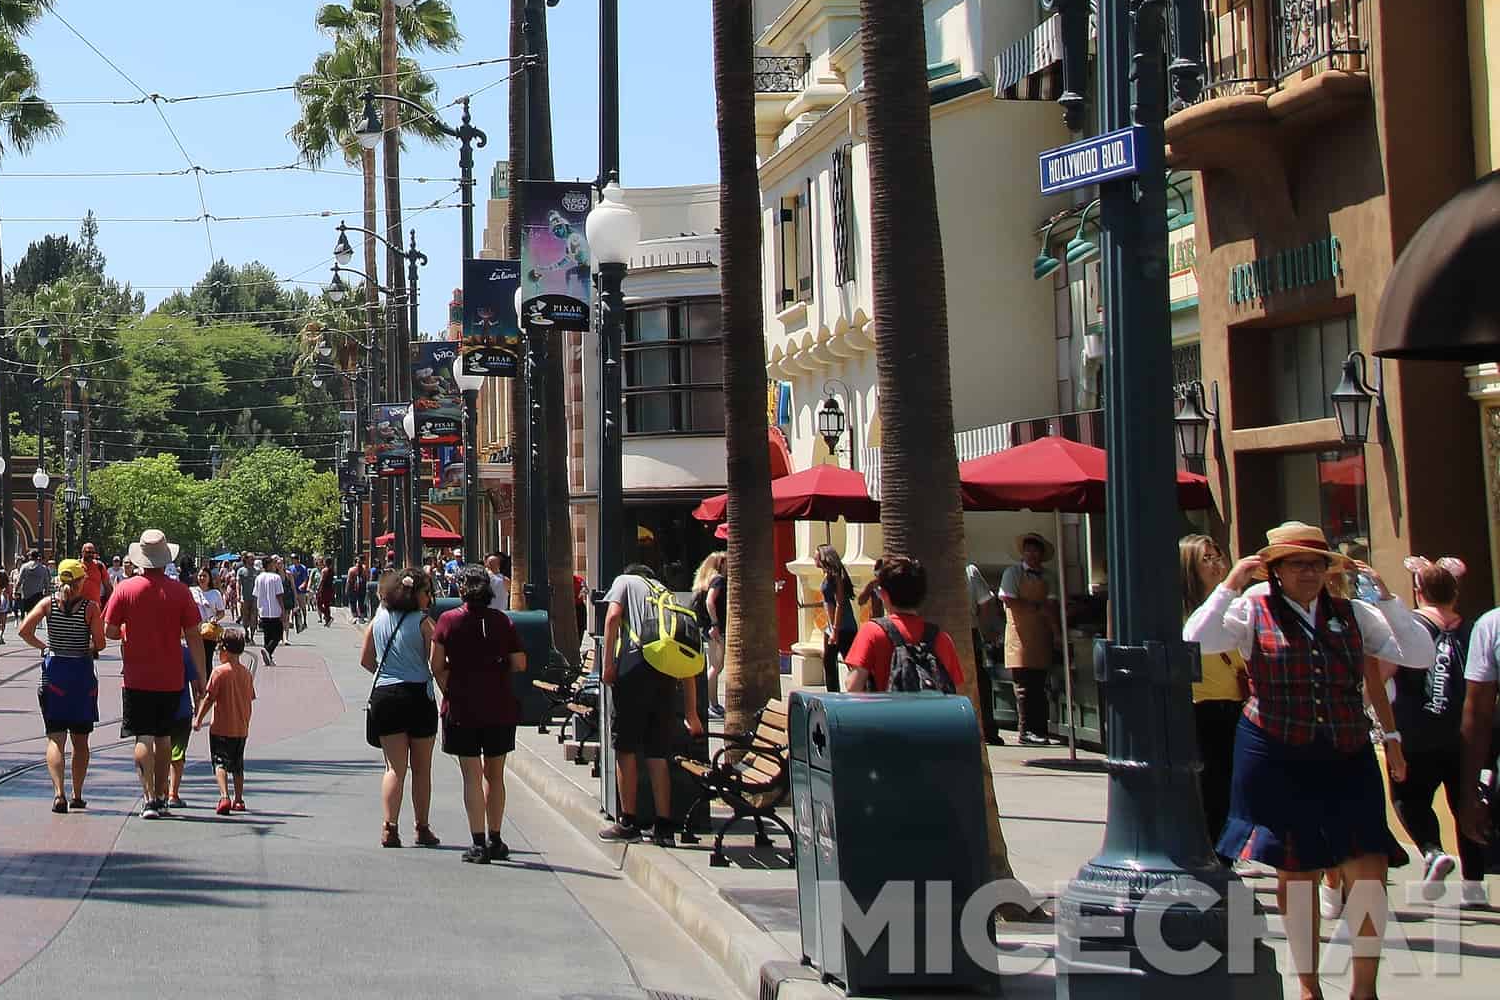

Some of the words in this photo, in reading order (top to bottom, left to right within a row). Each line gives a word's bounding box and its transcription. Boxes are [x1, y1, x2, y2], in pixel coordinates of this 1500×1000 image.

[1048, 147, 1098, 184] HOLLYWOOD
[1101, 140, 1126, 169] BLVD.
[553, 304, 583, 313] PIXAR
[432, 350, 454, 361] bao
[487, 355, 512, 363] PIXAR
